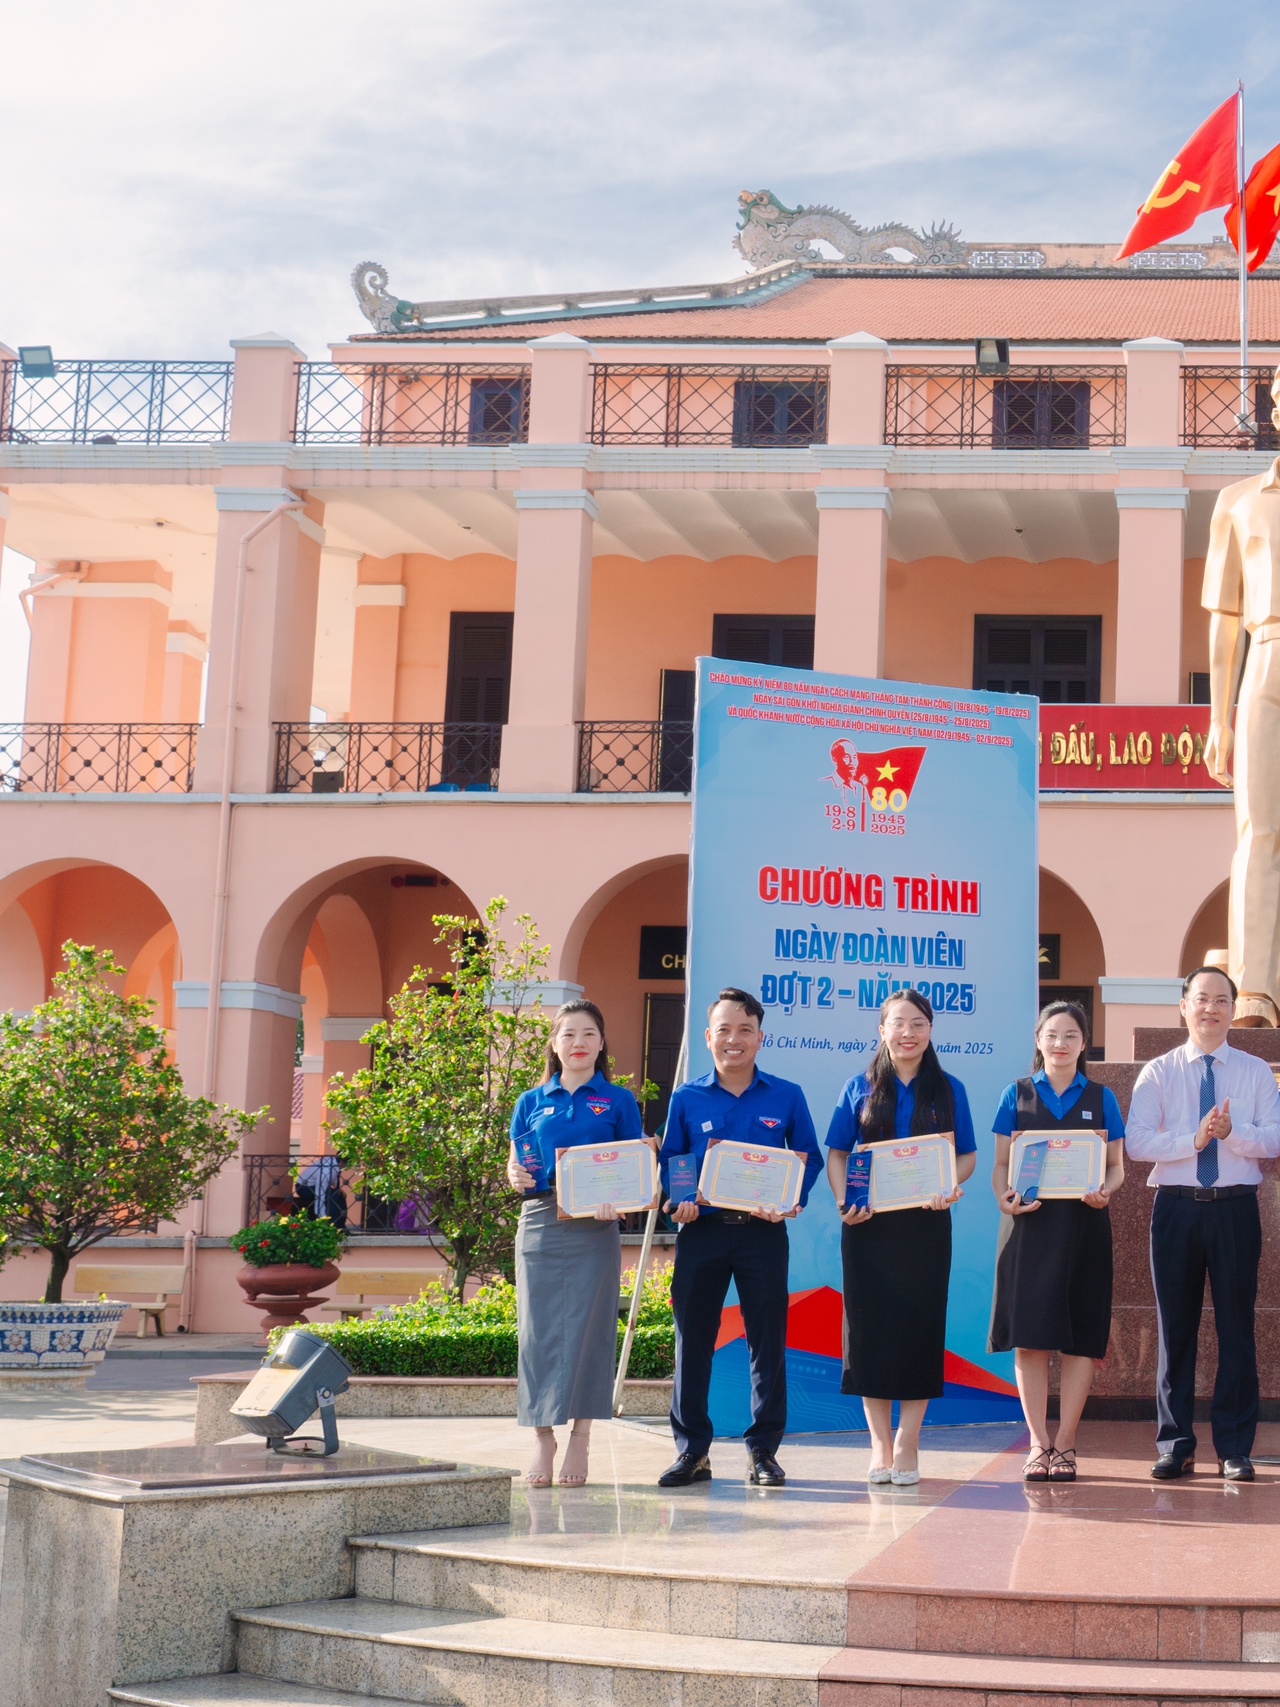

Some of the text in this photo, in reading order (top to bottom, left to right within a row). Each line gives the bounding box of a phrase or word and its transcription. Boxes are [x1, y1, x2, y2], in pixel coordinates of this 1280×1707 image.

[784, 680, 792, 690] 80
[954, 701, 988, 713] (19/8/1945
[995, 706, 1030, 718] 19/8/2025)
[910, 711, 947, 724] (25/8/1945
[954, 716, 990, 729] 25/8/2025)
[918, 728, 932, 738] NAM
[933, 729, 970, 742] (02/9/1945
[976, 734, 1013, 746] 02/9/2025)
[1051, 721, 1102, 772] ĐẤU,
[1110, 731, 1153, 766] LAO
[871, 787, 907, 812] 80
[825, 804, 856, 818] 19-8
[871, 813, 905, 825] 1945
[832, 818, 856, 831] 2-9
[871, 823, 905, 835] 2025
[759, 865, 979, 914] CHƯƠNG TRÌNH
[774, 923, 963, 967] NGÀY ĐOÀN VIÊN
[760, 970, 812, 1013] ĐỢT
[817, 977, 832, 1006] 2
[777, 1036, 797, 1049] Chí
[799, 1036, 834, 1051] Minh,
[838, 1038, 866, 1053] ngày
[936, 1040, 994, 1055] năm 2025
